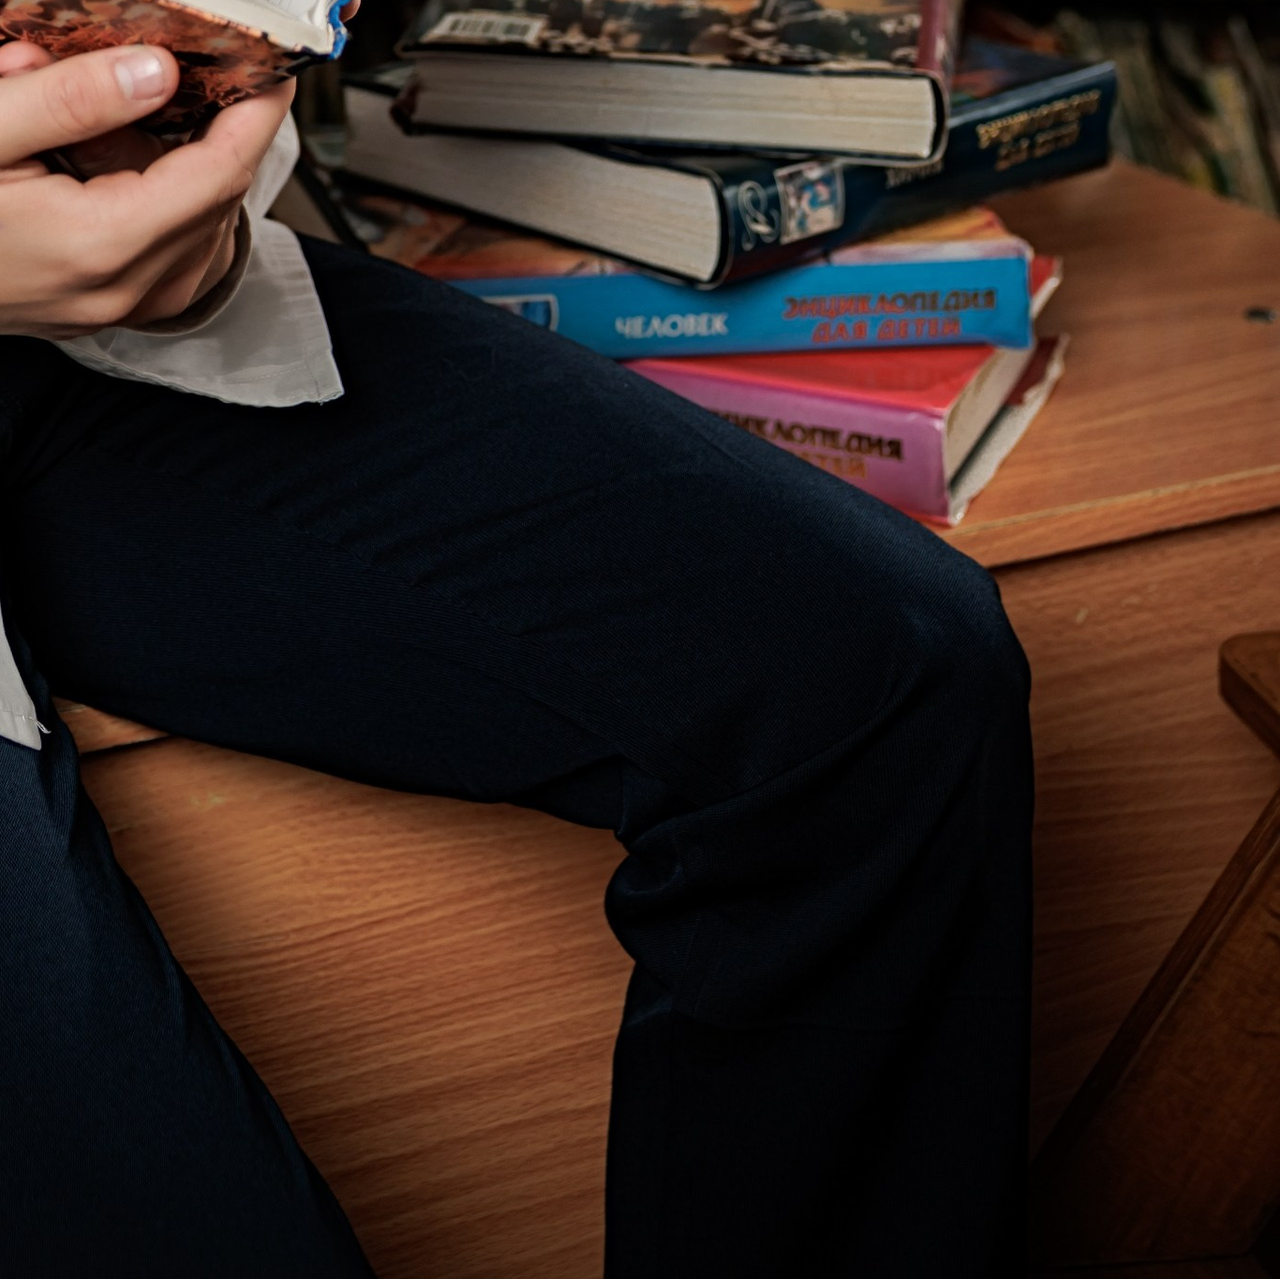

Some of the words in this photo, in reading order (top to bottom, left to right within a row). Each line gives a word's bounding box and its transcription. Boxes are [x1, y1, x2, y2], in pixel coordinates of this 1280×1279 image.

[783, 289, 997, 320] ЭНЦИКЛОПЕДИЯ
[616, 313, 729, 339] ЧЕЛОВЕК
[812, 319, 869, 342] ДЛЯ
[877, 317, 962, 340] ДЕТЕЙ
[714, 409, 904, 460] ИКЛОПЕДИЯ
